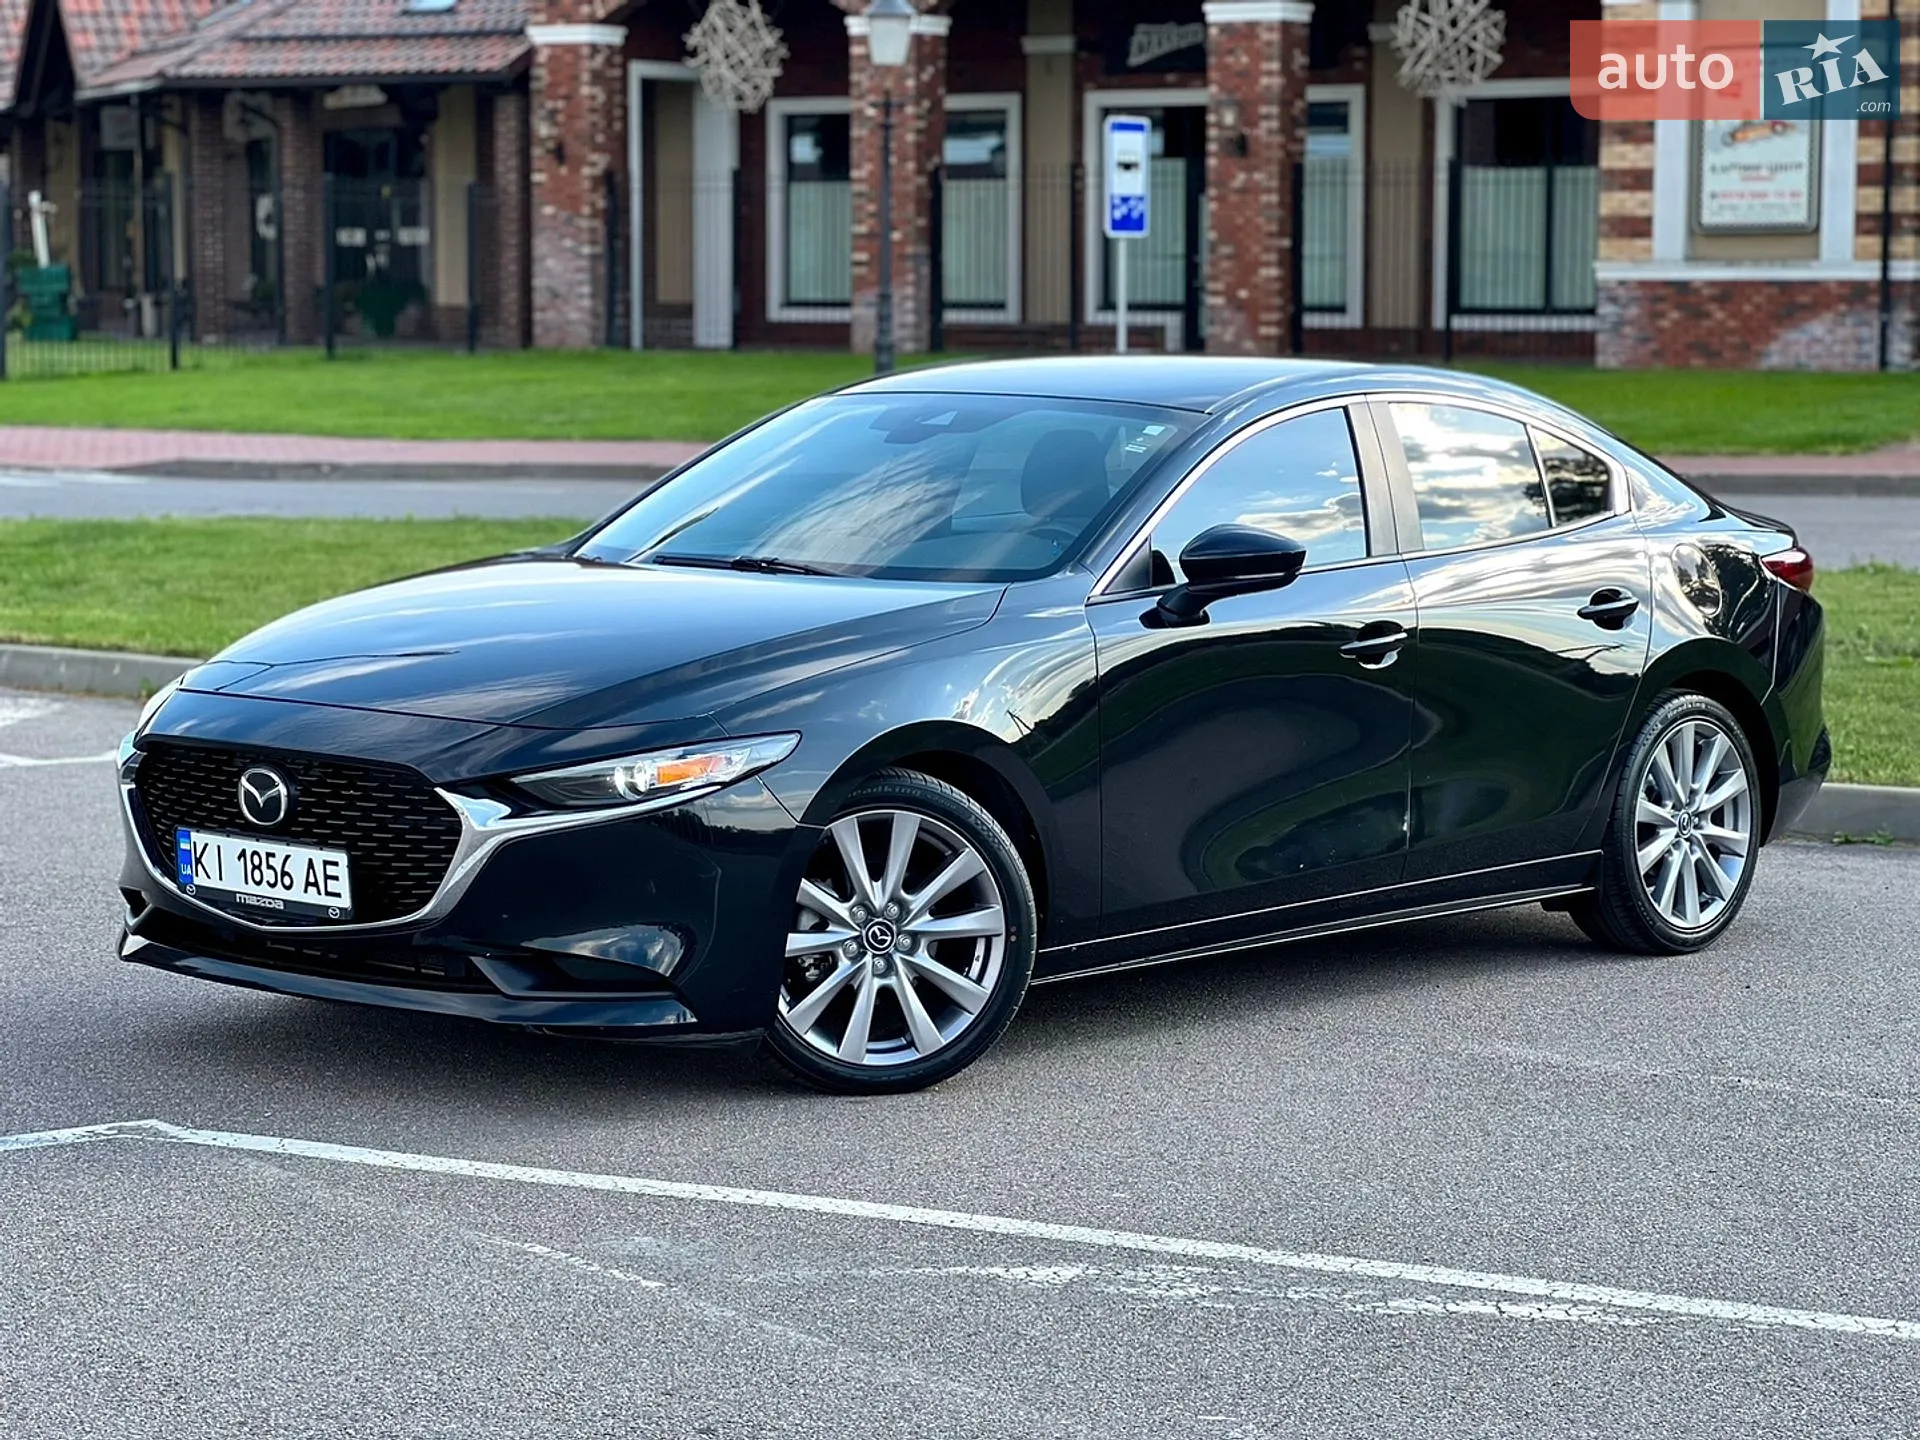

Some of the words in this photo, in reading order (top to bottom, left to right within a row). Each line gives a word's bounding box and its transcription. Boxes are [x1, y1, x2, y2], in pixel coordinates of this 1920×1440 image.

[181, 863, 192, 876] UA
[193, 841, 224, 881] KI
[237, 848, 294, 891] 1856
[304, 857, 342, 898] AE
